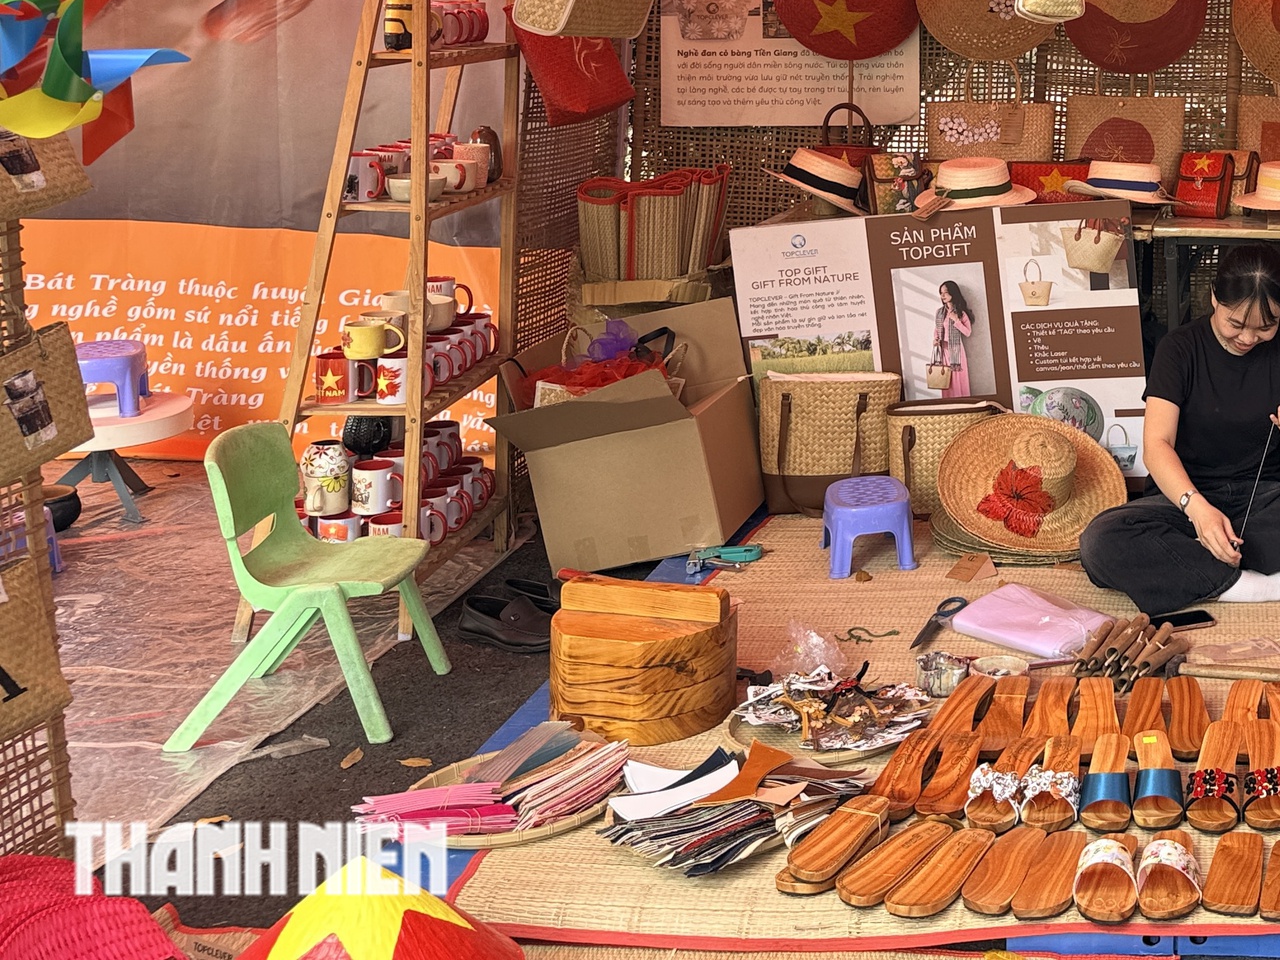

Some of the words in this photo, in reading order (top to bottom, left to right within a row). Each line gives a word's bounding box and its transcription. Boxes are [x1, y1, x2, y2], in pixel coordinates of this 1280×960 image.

[773, 49, 798, 58] Giang
[890, 227, 925, 246] SẢN
[930, 222, 977, 242] PHẨM
[781, 248, 819, 258] TOPCLEVER
[898, 242, 972, 261] TOPGIFT
[751, 280, 776, 290] GIFT
[778, 277, 811, 287] FROM
[814, 272, 859, 284] NATURE
[778, 268, 801, 278] TOP
[803, 266, 828, 275] GIFT
[25, 271, 76, 291] Bát
[89, 272, 167, 297] Tràng
[178, 277, 238, 303] thuộc
[51, 295, 119, 321] nghề
[127, 297, 176, 322] gốm
[184, 306, 212, 324] sứ
[218, 304, 259, 327] nổi
[172, 330, 194, 350] là
[201, 330, 249, 354] dấu
[257, 331, 292, 354] ấn
[195, 357, 267, 383] thống
